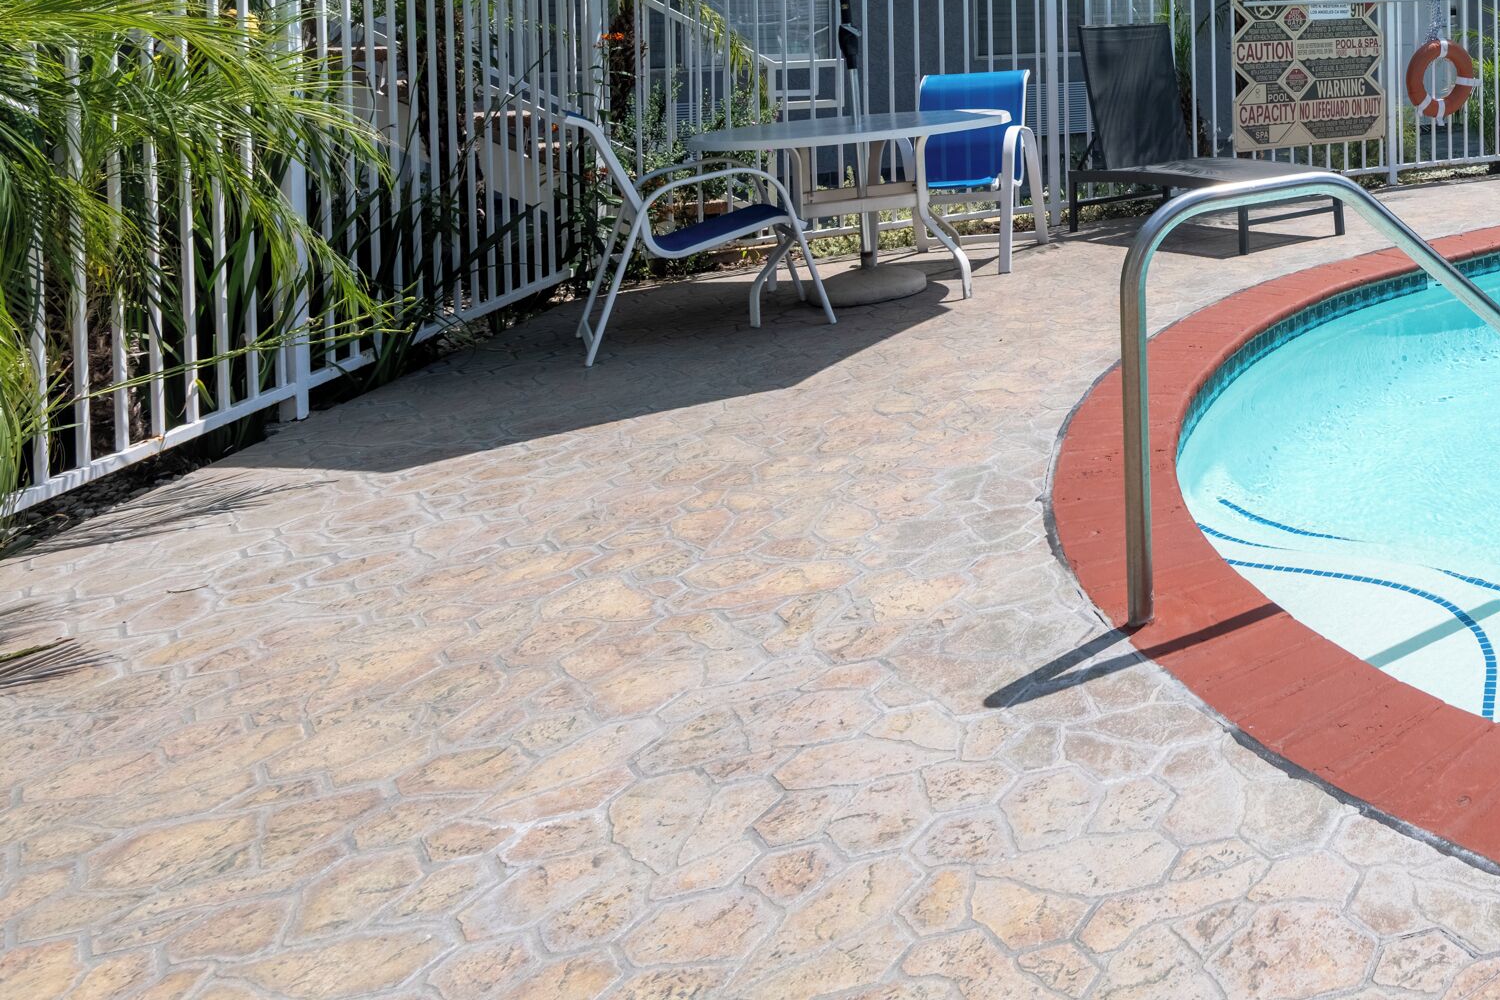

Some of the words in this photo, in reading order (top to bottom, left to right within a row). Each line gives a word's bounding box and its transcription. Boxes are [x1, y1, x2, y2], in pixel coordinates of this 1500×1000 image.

[1350, 2, 1364, 18] 911
[1236, 41, 1294, 63] CAUTION
[1335, 39, 1356, 49] POOL
[1357, 39, 1362, 48] &
[1364, 38, 1379, 48] SPA
[1316, 77, 1366, 99] WARNING
[1267, 93, 1290, 103] POOL
[1239, 103, 1297, 125] CAPACITY
[1299, 102, 1310, 121] NO
[1312, 99, 1350, 120] LIFEGUARD
[1351, 98, 1362, 116] ON
[1364, 97, 1382, 115] DUTY
[1256, 131, 1269, 140] SPA
